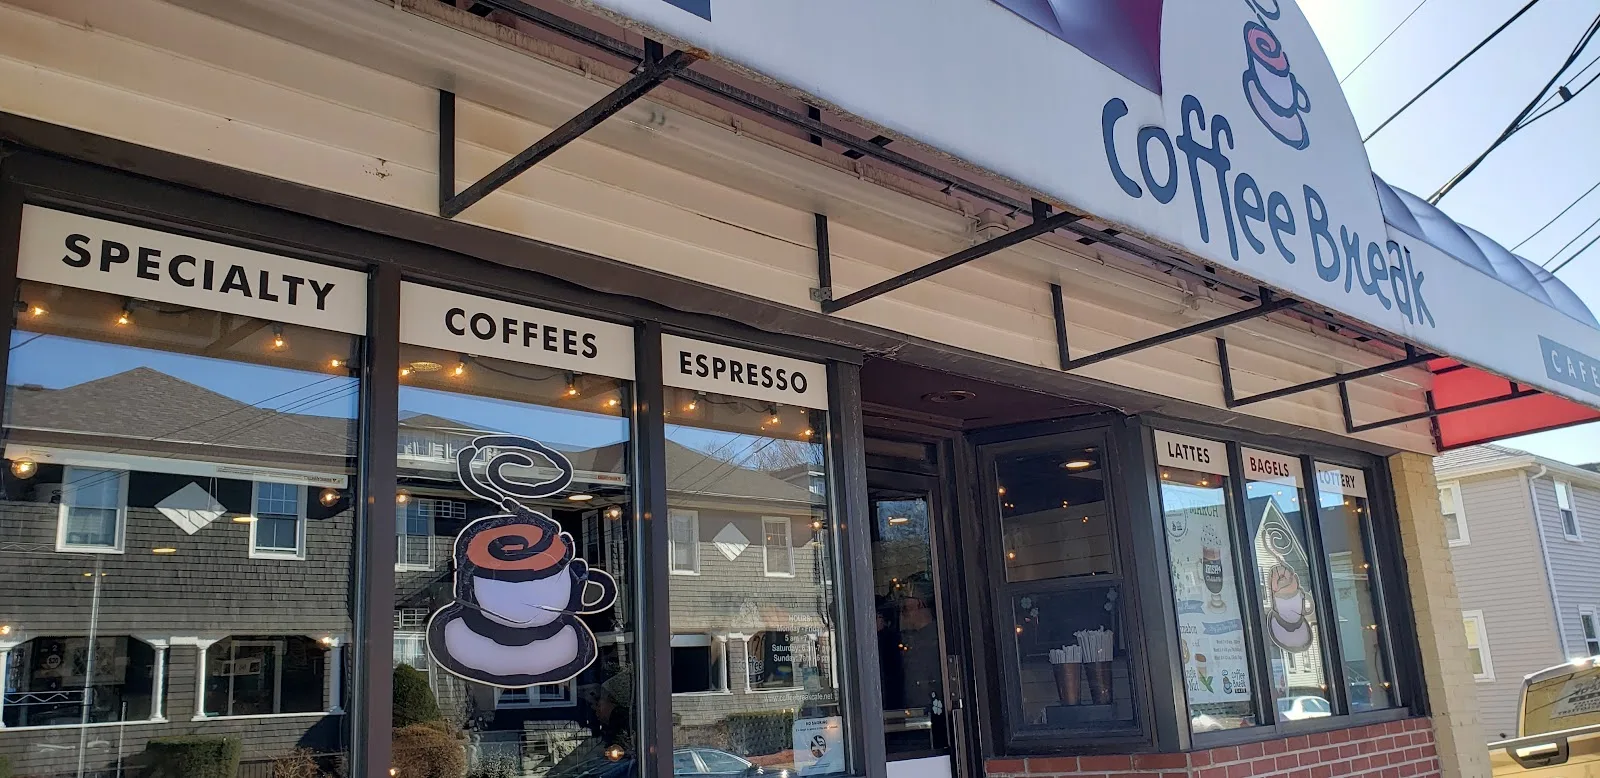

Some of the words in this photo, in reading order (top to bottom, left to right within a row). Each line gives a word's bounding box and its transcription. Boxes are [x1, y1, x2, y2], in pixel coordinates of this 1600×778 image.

[1101, 94, 1296, 265] Coffee
[1302, 184, 1436, 329] Break
[61, 233, 336, 311] SPECIALTY
[444, 307, 599, 359] COFFEES
[678, 350, 808, 394] ESPRESSO
[1551, 350, 1600, 389] CAFE
[1167, 441, 1210, 464] LATTES
[1249, 456, 1290, 477] BAGELS
[1318, 469, 1356, 489] LOTTERY
[784, 634, 789, 642] 5
